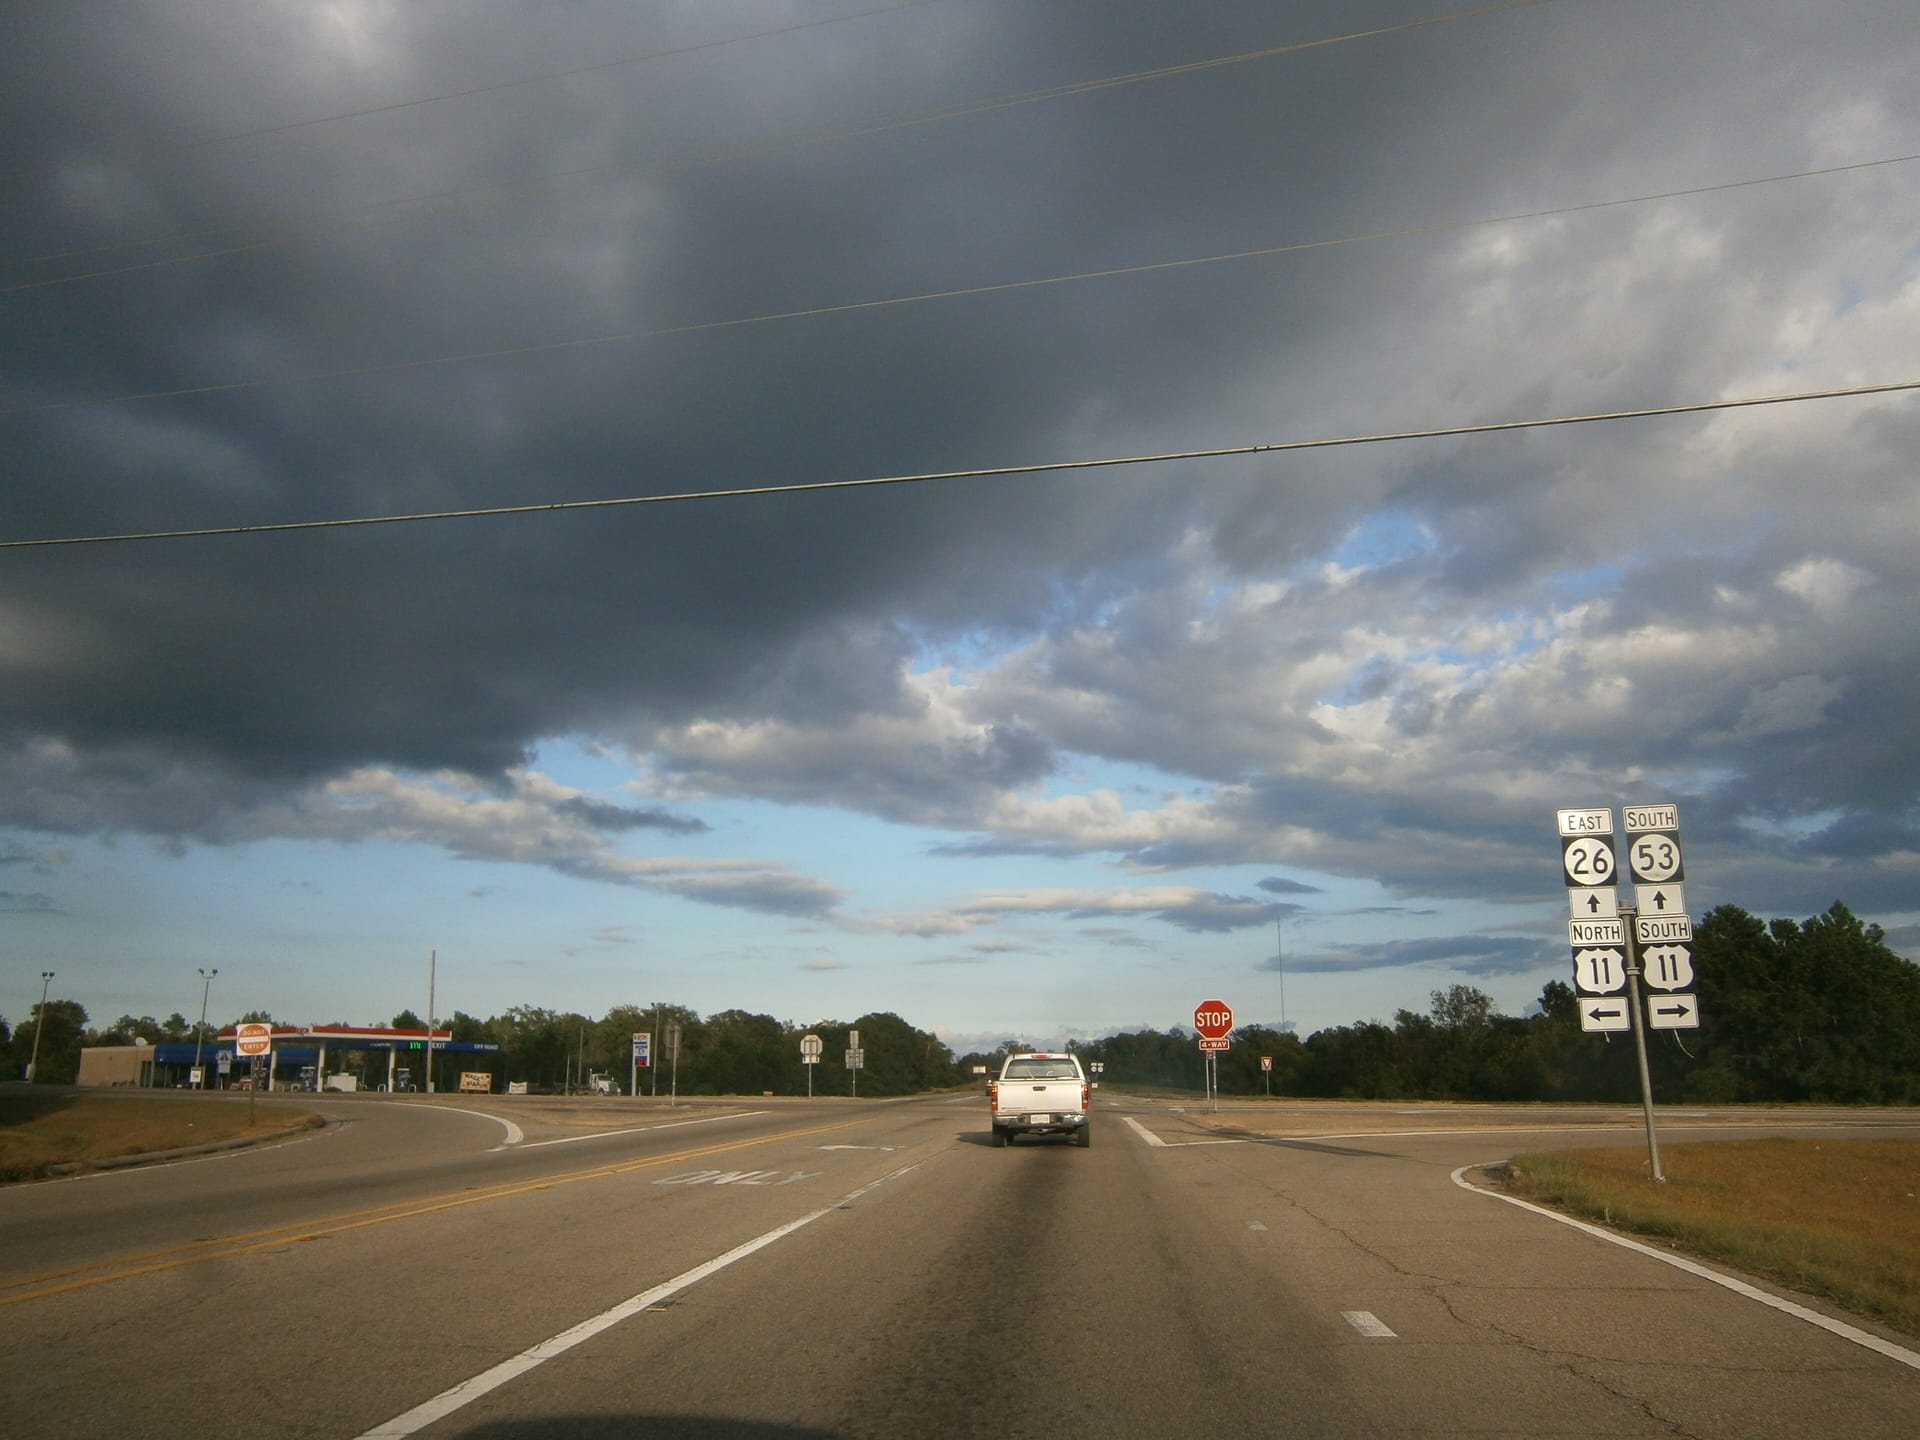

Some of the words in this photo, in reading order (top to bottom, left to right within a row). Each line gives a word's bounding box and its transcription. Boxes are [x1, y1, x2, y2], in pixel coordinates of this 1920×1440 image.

[1568, 815, 1602, 831] EAST
[1627, 811, 1675, 828] SOUTH
[1572, 848, 1608, 875] 26
[1638, 843, 1674, 871] 53
[1573, 925, 1620, 941] NORTH
[1640, 922, 1688, 938] SOUTH
[1590, 957, 1611, 985] 11
[1658, 953, 1679, 982] 11
[1196, 1011, 1230, 1027] STOP
[651, 1170, 825, 1186] ONLY
